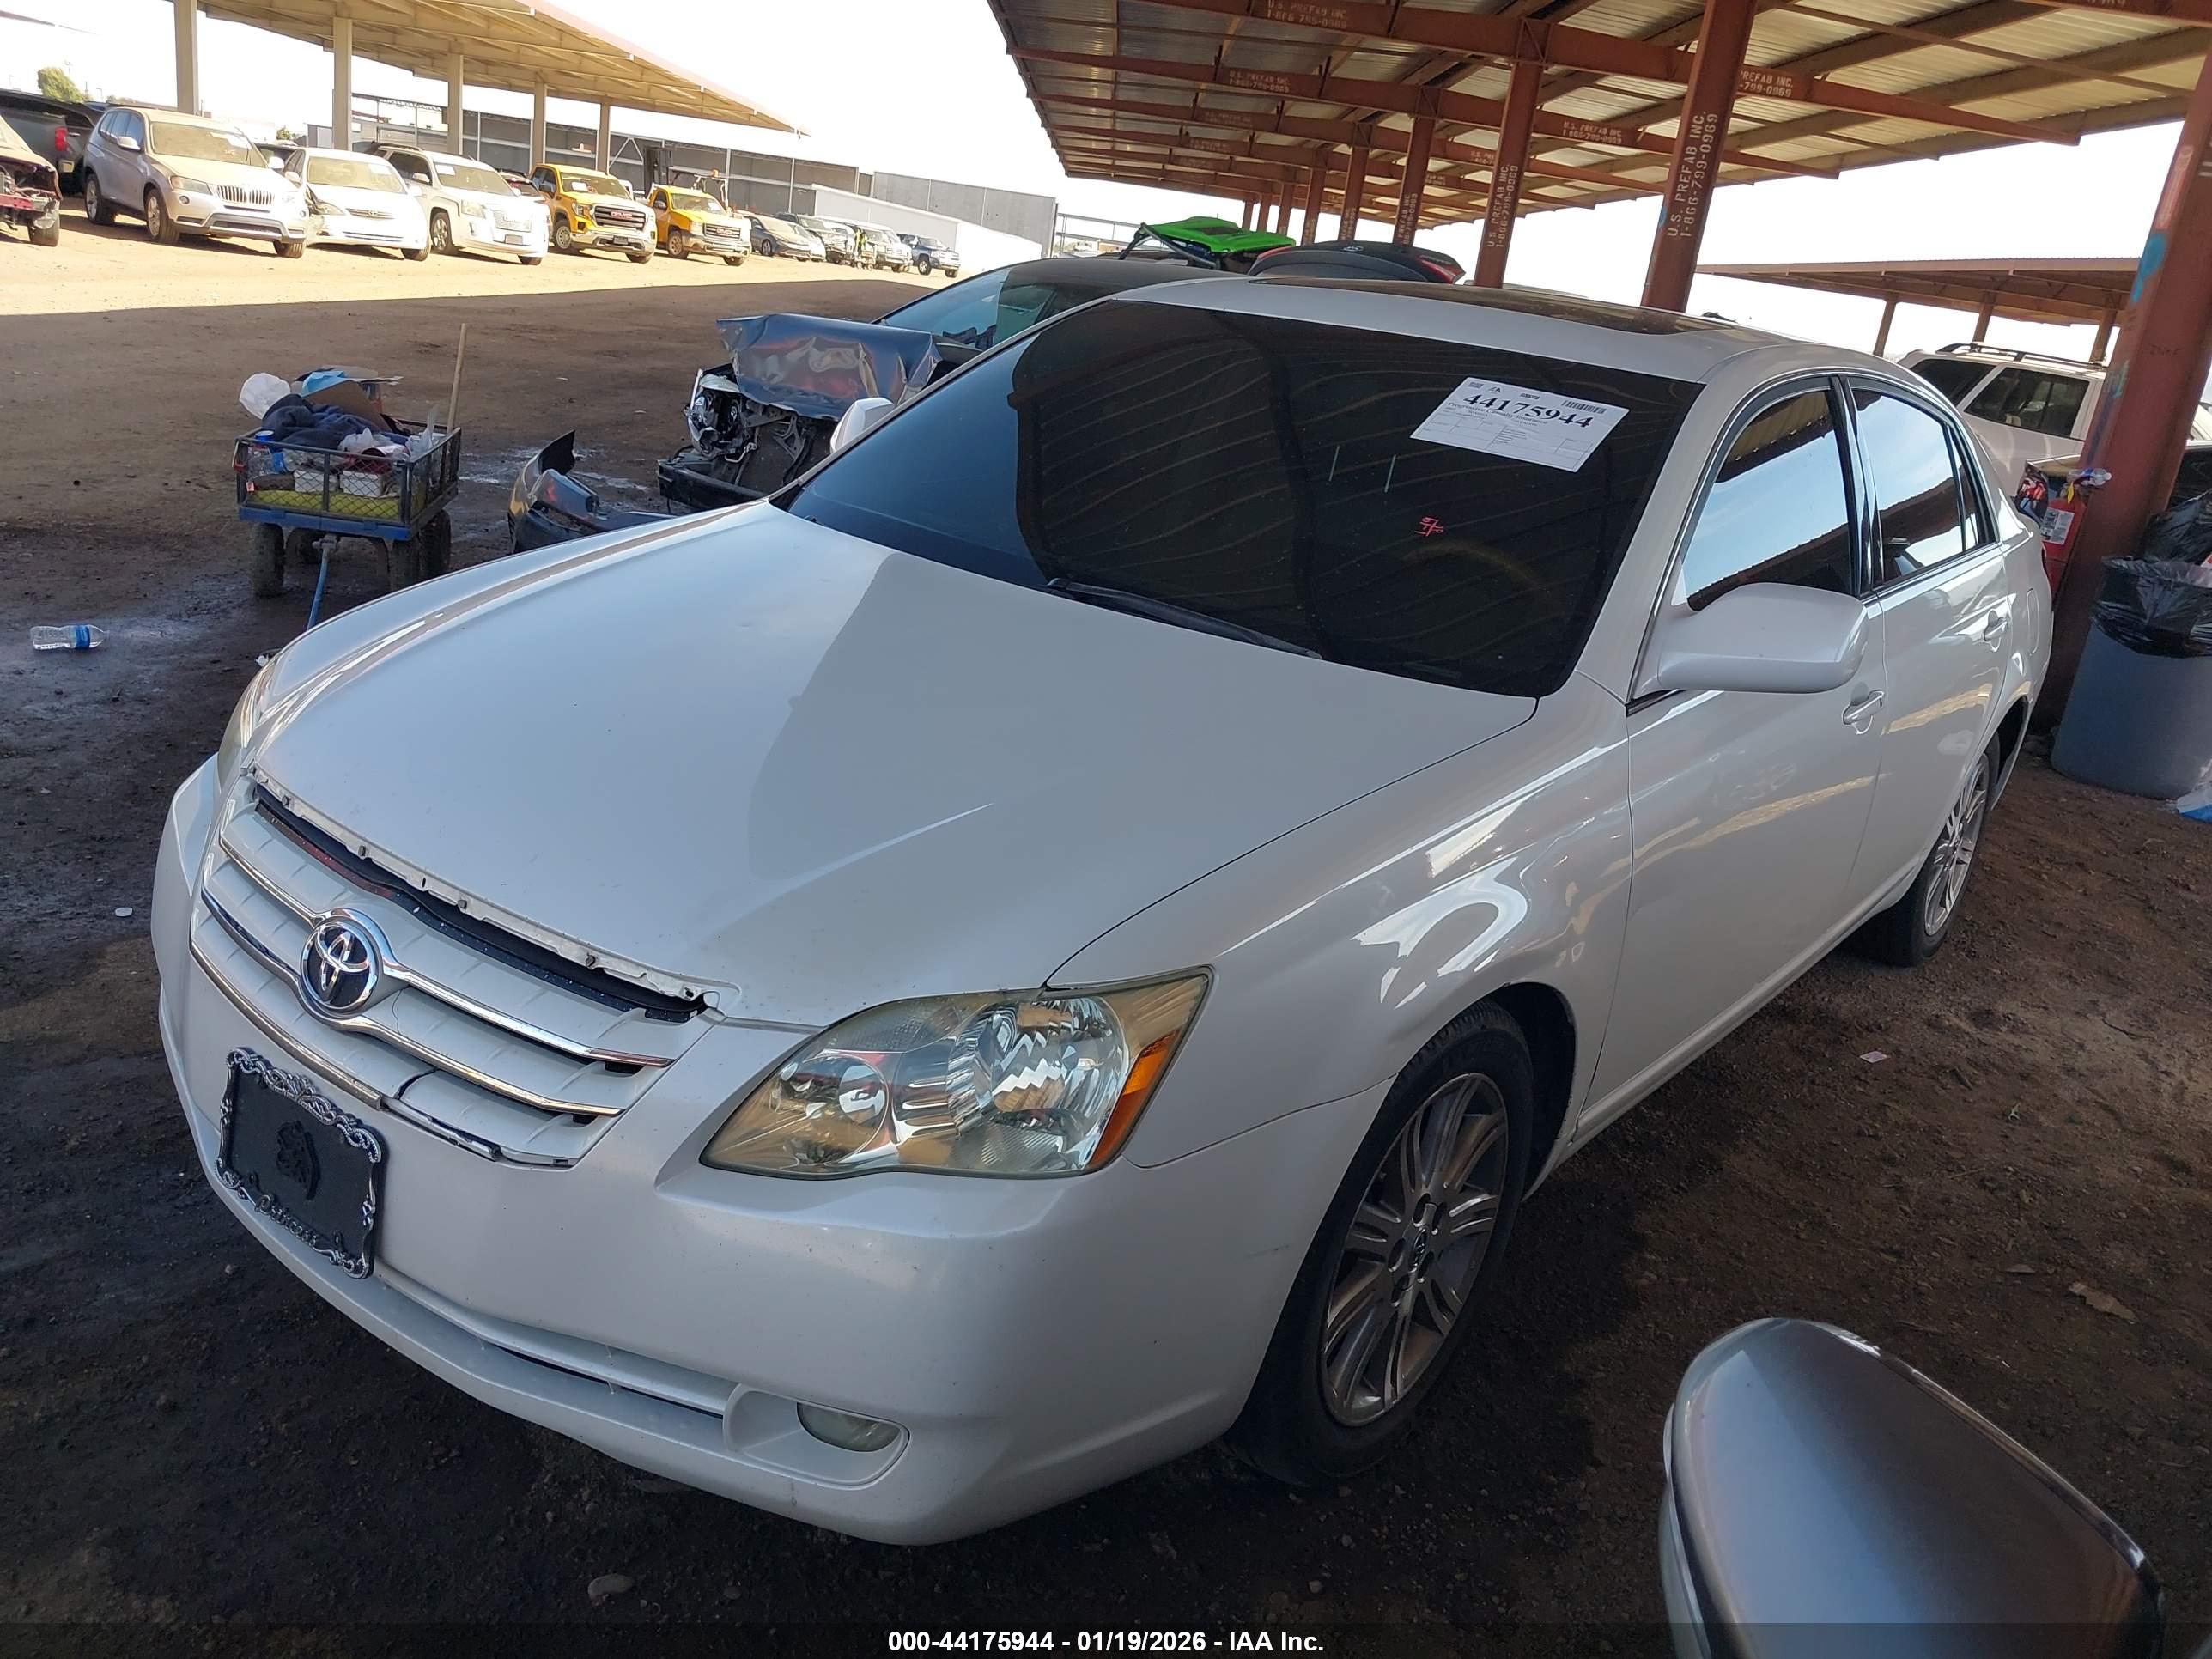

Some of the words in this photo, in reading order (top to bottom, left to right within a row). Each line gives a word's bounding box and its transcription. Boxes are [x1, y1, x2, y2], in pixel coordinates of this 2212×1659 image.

[1674, 146, 1698, 202] PREFAB
[1680, 112, 1718, 237] 1-866-799-0969
[1491, 186, 1505, 224] PREFAB
[1667, 210, 1684, 237] U.S.
[1463, 394, 1594, 428] 44175944
